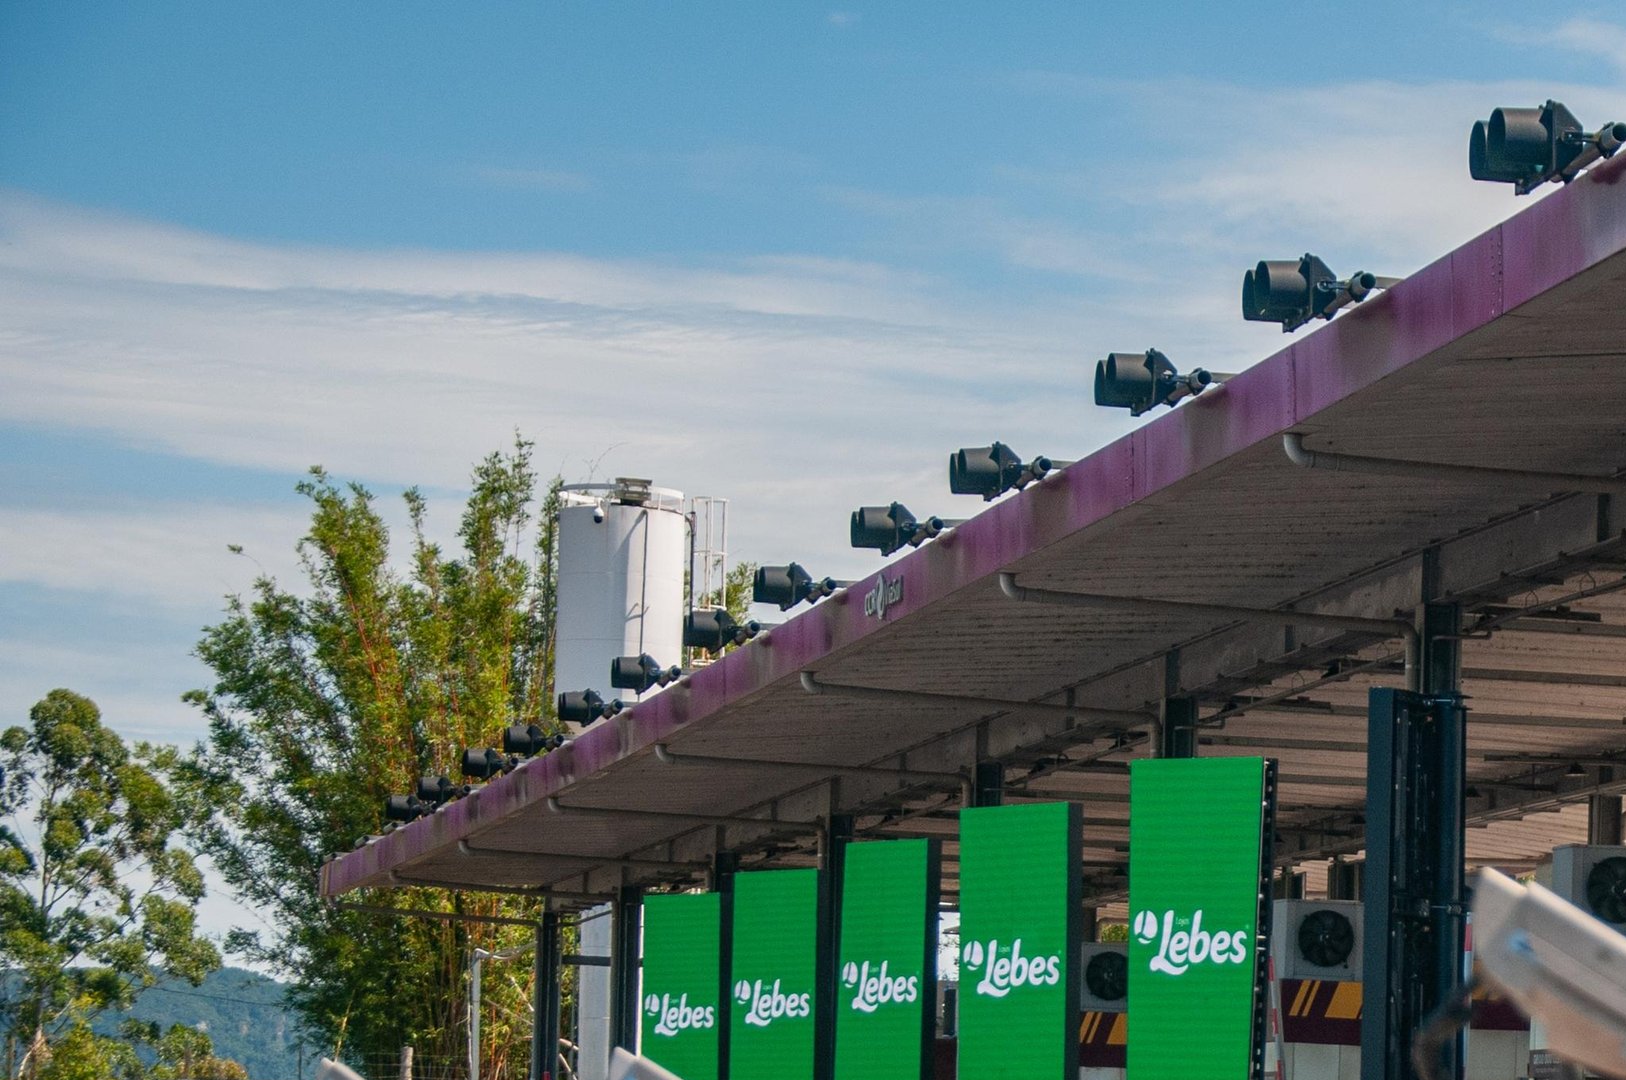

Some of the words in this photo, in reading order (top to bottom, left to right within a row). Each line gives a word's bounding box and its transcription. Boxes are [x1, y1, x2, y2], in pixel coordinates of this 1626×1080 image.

[976, 938, 1061, 998] Lebes
[1149, 909, 1248, 976] Lebes
[744, 978, 810, 1027] Lebes
[851, 960, 918, 1013] Lebes
[654, 993, 715, 1037] Lebes
